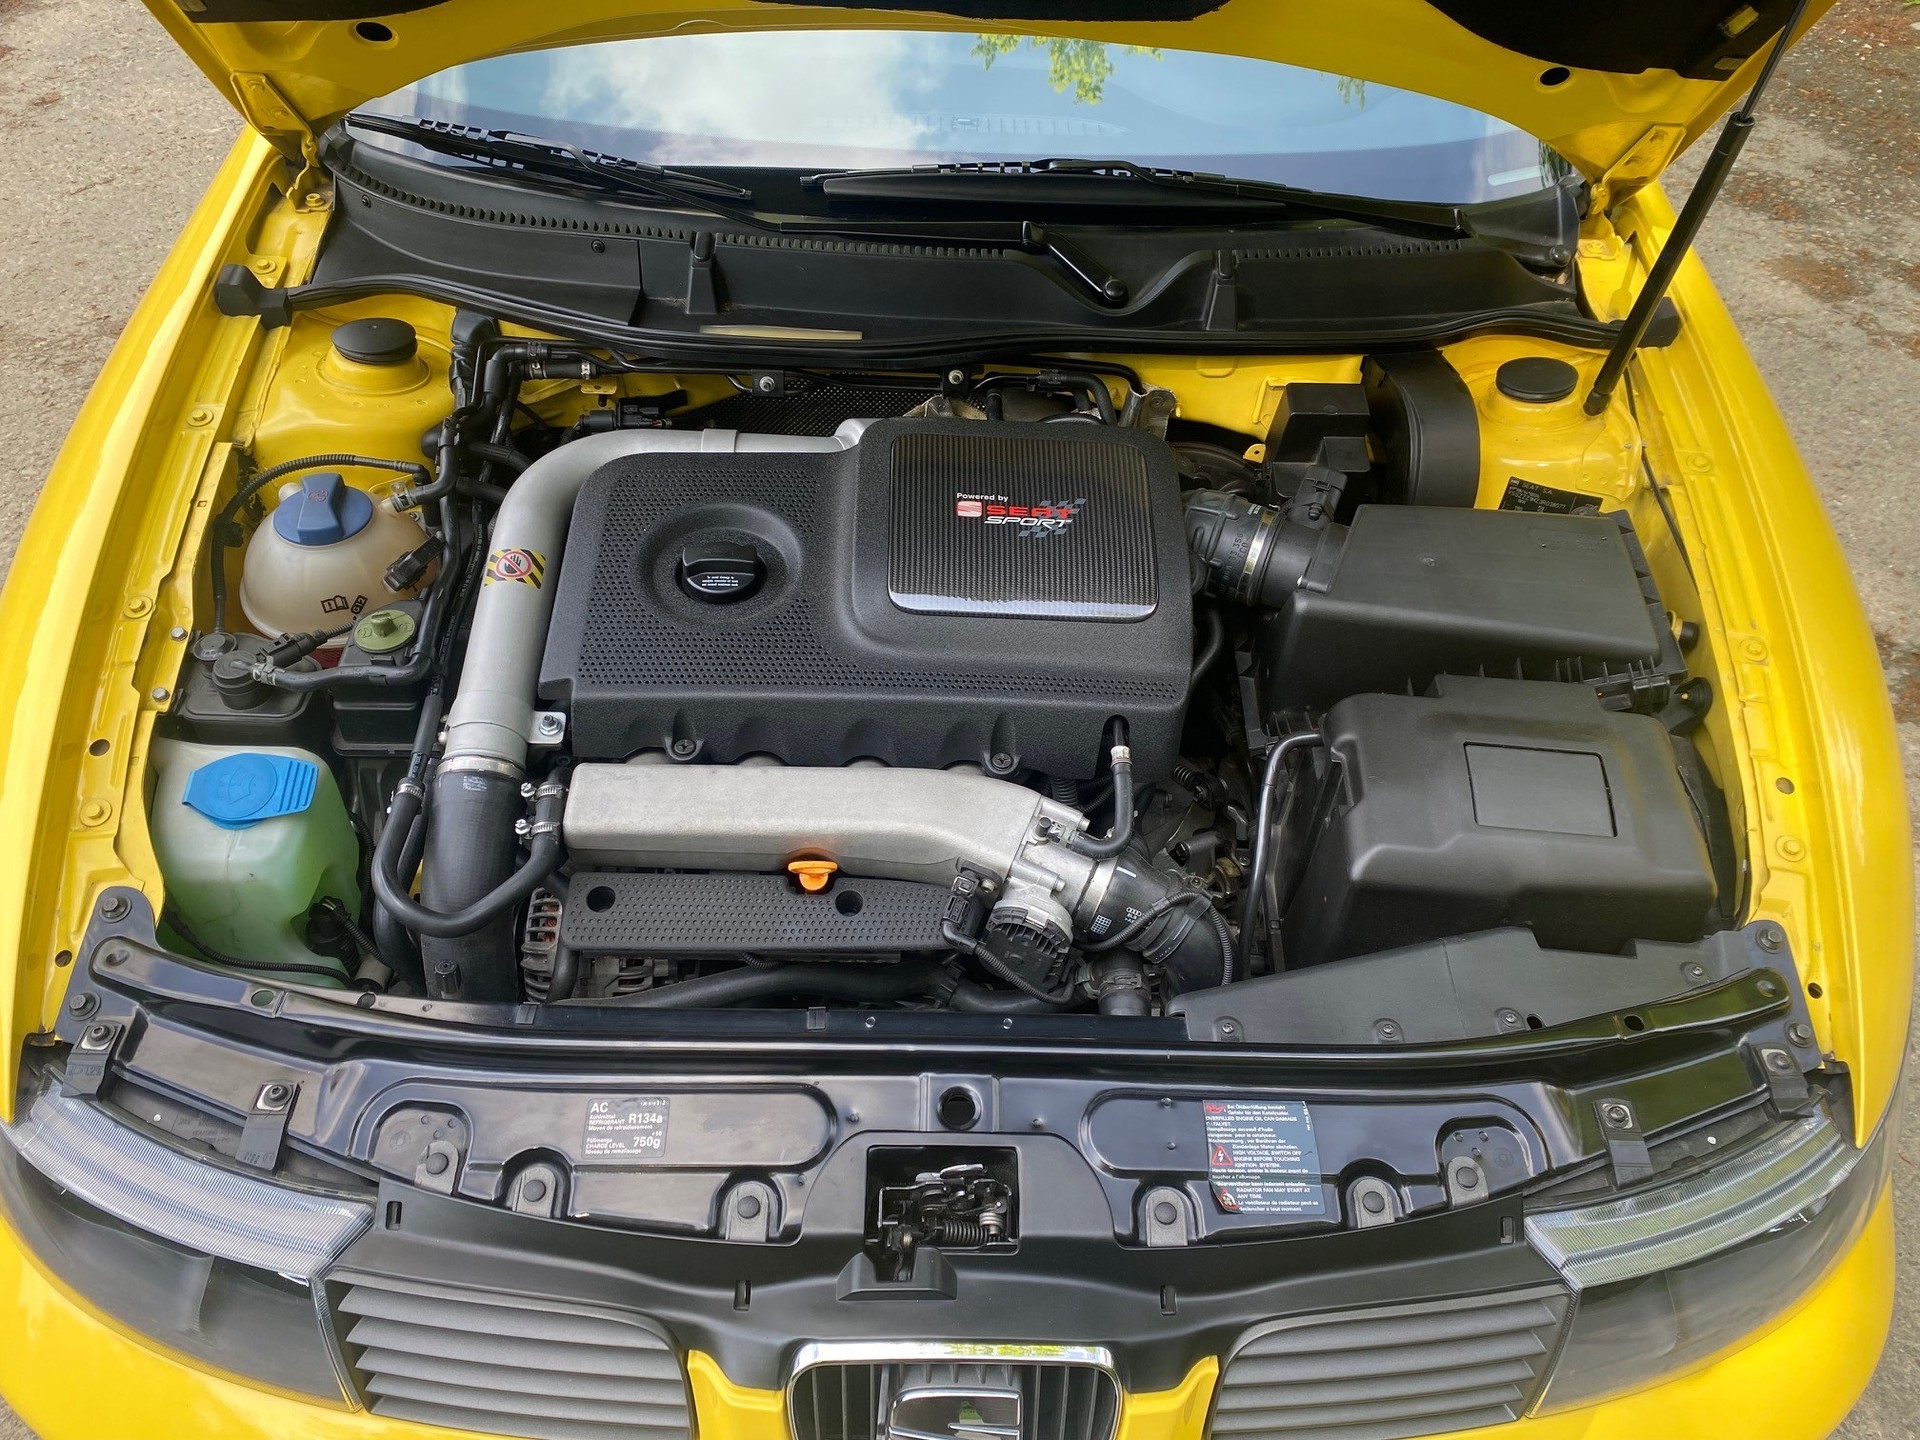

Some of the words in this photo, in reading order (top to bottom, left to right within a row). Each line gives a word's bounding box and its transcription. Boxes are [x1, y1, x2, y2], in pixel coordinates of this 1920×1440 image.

[986, 505, 1073, 519] SEAT
[984, 516, 1073, 529] SPORT
[353, 597, 366, 612] G12
[590, 1102, 608, 1113] AC
[629, 1113, 663, 1124] R134a
[633, 1137, 660, 1149] 750g
